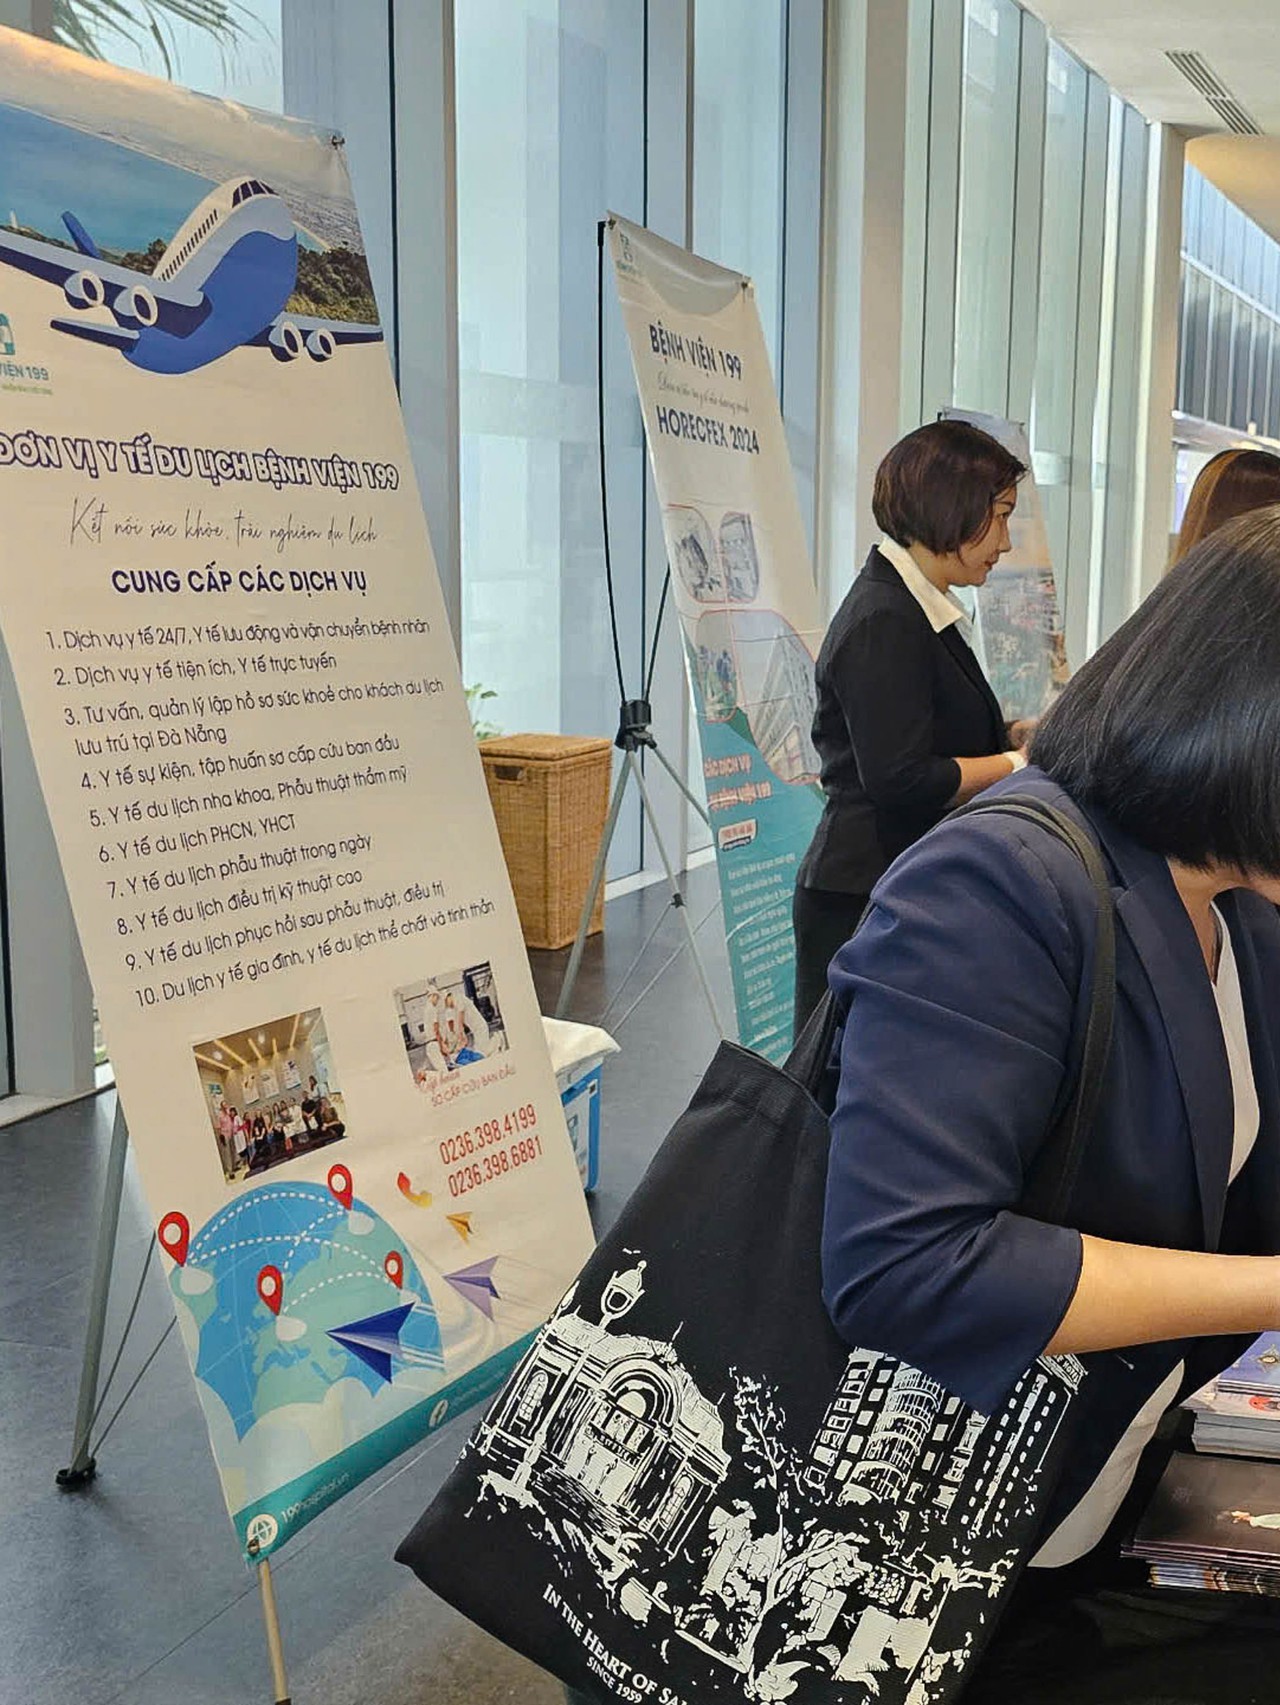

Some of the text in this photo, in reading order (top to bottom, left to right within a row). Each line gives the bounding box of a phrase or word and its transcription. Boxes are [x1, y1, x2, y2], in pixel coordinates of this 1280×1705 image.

[26, 366, 49, 381] 199
[650, 320, 742, 380] BỆNH VIỆN 199
[655, 404, 760, 454] HORECFEX 2024
[62, 437, 99, 478] VỊ
[97, 441, 117, 472] Y
[120, 432, 153, 474] TẾ
[153, 445, 192, 477] DU
[194, 449, 252, 486] LỊCH
[252, 448, 312, 490] BỆNH
[311, 454, 362, 493] VIỆN
[362, 462, 399, 490] 199
[111, 561, 367, 597] CUNG CẤP CÁC DỊCH VỤ
[46, 631, 61, 649] 1.
[64, 631, 101, 651] Dịch
[103, 633, 124, 650] vụ
[138, 625, 154, 646] tế
[193, 627, 203, 643] Y
[206, 624, 221, 643] tế
[222, 625, 243, 641] lưu
[245, 624, 281, 644] động
[284, 623, 299, 640] và
[301, 622, 325, 641] vận
[326, 617, 370, 639] chuyển
[54, 651, 337, 687] 2. Dịch vụ y tế tiện Y tế trực tuyến
[64, 707, 81, 726] 3.
[83, 705, 104, 724] Tư
[149, 697, 190, 720] quản
[192, 696, 205, 717] lý
[208, 695, 233, 715] lập
[258, 694, 274, 709] sơ
[277, 690, 300, 707] sức
[338, 686, 363, 702] cho
[364, 682, 403, 699] khách
[405, 680, 422, 695] du
[423, 677, 444, 697] lịch
[75, 738, 103, 756] lưu
[106, 733, 129, 753] trú
[133, 732, 155, 752] tại
[157, 728, 182, 747] Đà
[81, 773, 97, 790] 4.
[99, 770, 110, 788] Y
[115, 764, 134, 786] tế
[138, 766, 156, 786] sự
[198, 756, 226, 778] tập
[228, 750, 267, 772] huấn
[269, 751, 285, 767] sơ
[288, 744, 316, 765] cấp
[318, 742, 344, 760] cứu
[345, 740, 372, 757] ban
[90, 809, 106, 828] 5.
[108, 806, 119, 824] Y
[124, 801, 142, 822] tế
[146, 800, 168, 819] du
[171, 798, 199, 819] lịch
[202, 792, 232, 811] nha
[316, 773, 350, 793] thuật
[99, 845, 115, 863] 6.
[117, 842, 128, 860] Y
[133, 835, 151, 857] tế
[156, 835, 177, 853] du
[180, 831, 208, 852] lịch
[258, 813, 296, 835] YHCT
[106, 833, 372, 899] 7. Y tế du lịch thuật trong ngày
[117, 918, 133, 936] 8.
[135, 912, 146, 931] Y
[151, 905, 169, 928] tế
[173, 905, 194, 924] du
[197, 900, 224, 922] lịch
[262, 884, 277, 905] trị
[278, 881, 294, 901] kỹ
[297, 875, 333, 895] thuật
[336, 870, 363, 887] cao
[125, 954, 142, 971] 9.
[144, 948, 155, 967] Y
[160, 941, 177, 963] tế
[181, 940, 202, 958] du
[205, 935, 232, 957] lịch
[235, 924, 273, 949] phục
[300, 911, 324, 929] sau
[432, 880, 444, 898] trị
[135, 987, 160, 1007] 10.
[161, 983, 185, 1001] Du
[188, 974, 215, 997] lịch
[216, 972, 226, 990] y
[228, 961, 244, 982] tế
[247, 959, 270, 981] gia
[318, 937, 333, 958] tế
[335, 936, 352, 954] du
[355, 931, 377, 951] lịch
[378, 919, 399, 942] thể
[401, 914, 428, 936] chất
[439, 1103, 537, 1165] 0236.398.4199
[448, 1135, 544, 1197] 0236.398.6881
[542, 1583, 688, 1705] IN THE HEART OF SA
[586, 1656, 643, 1704] SINCE 1959
